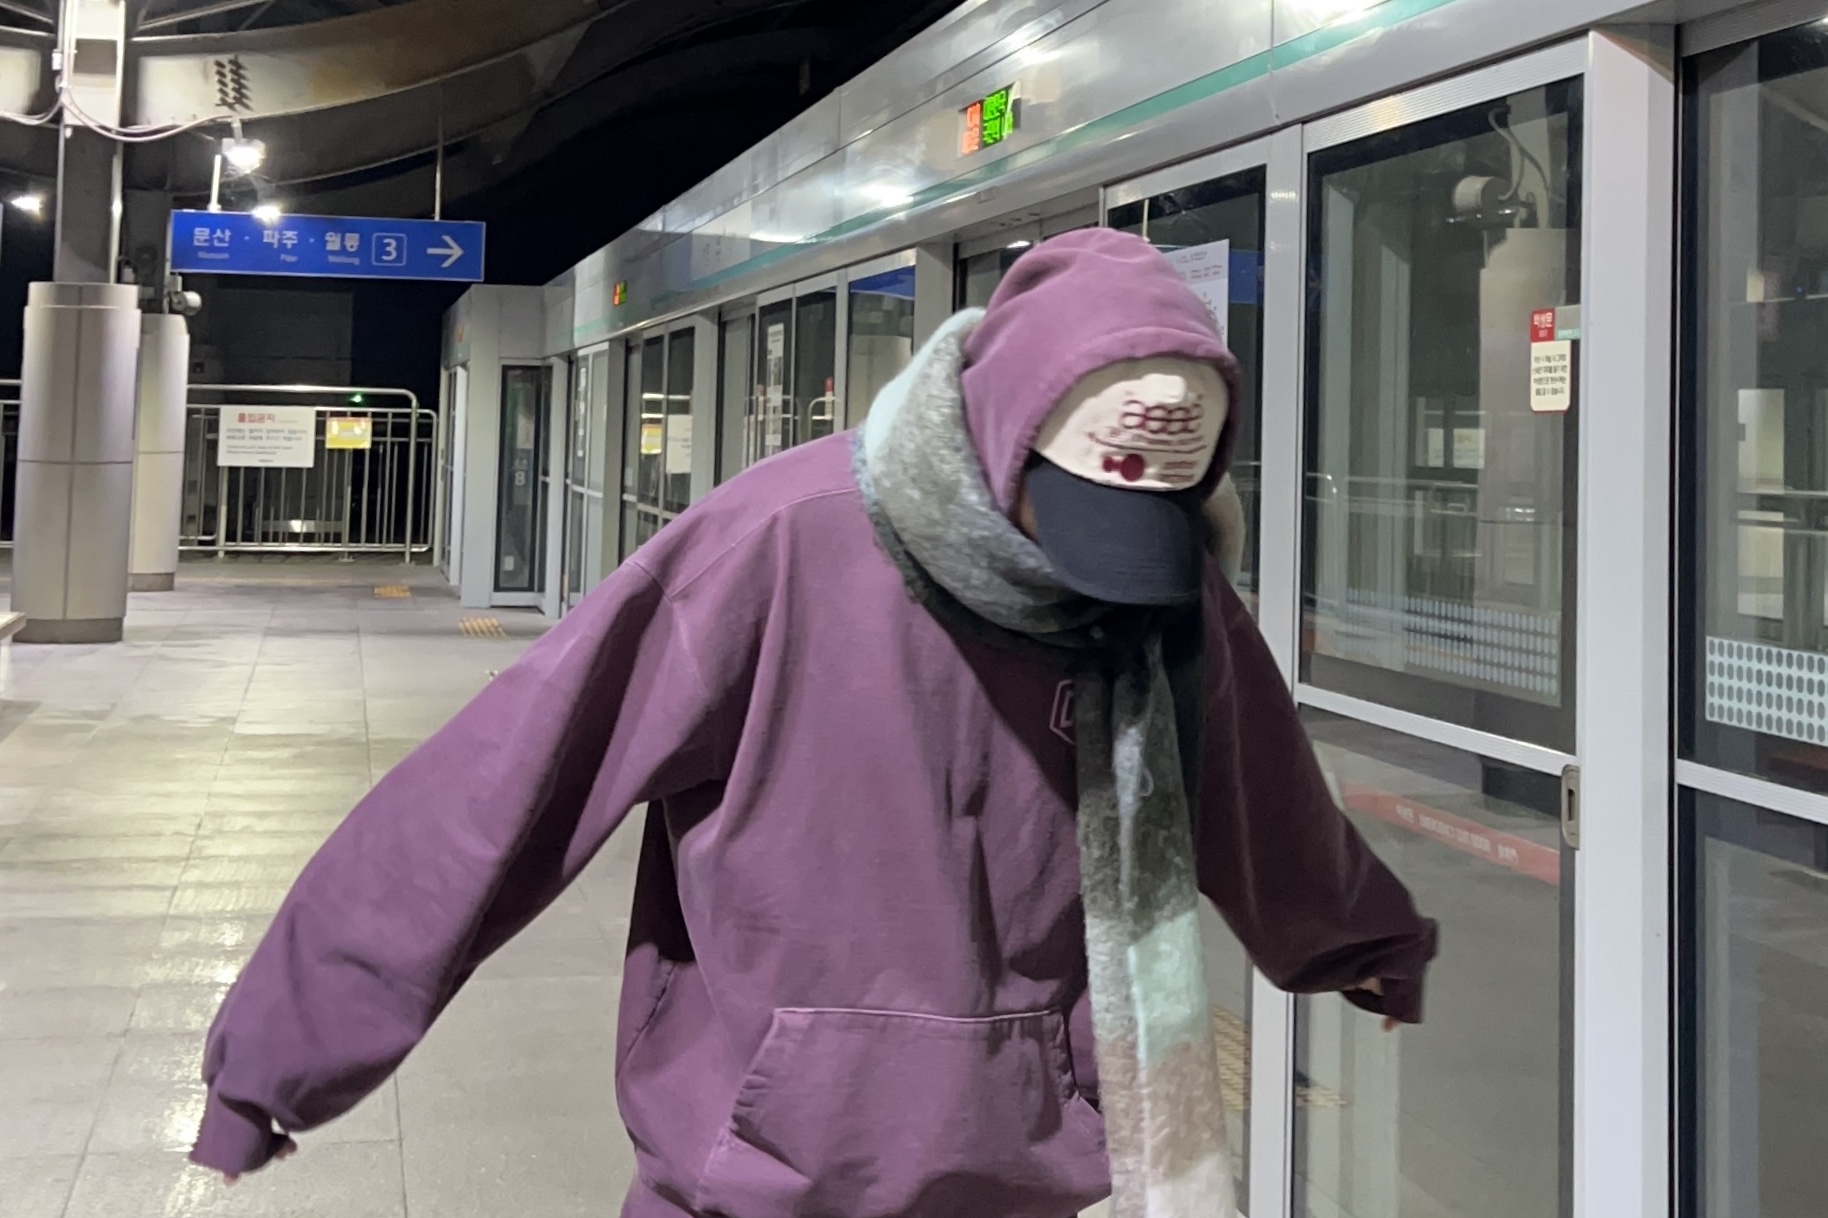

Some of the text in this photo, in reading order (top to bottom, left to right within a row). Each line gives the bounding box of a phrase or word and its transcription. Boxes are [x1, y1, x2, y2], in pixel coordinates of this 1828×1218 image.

[193, 227, 231, 247] 문산
[263, 230, 298, 249] 파주
[381, 238, 397, 261] 3
